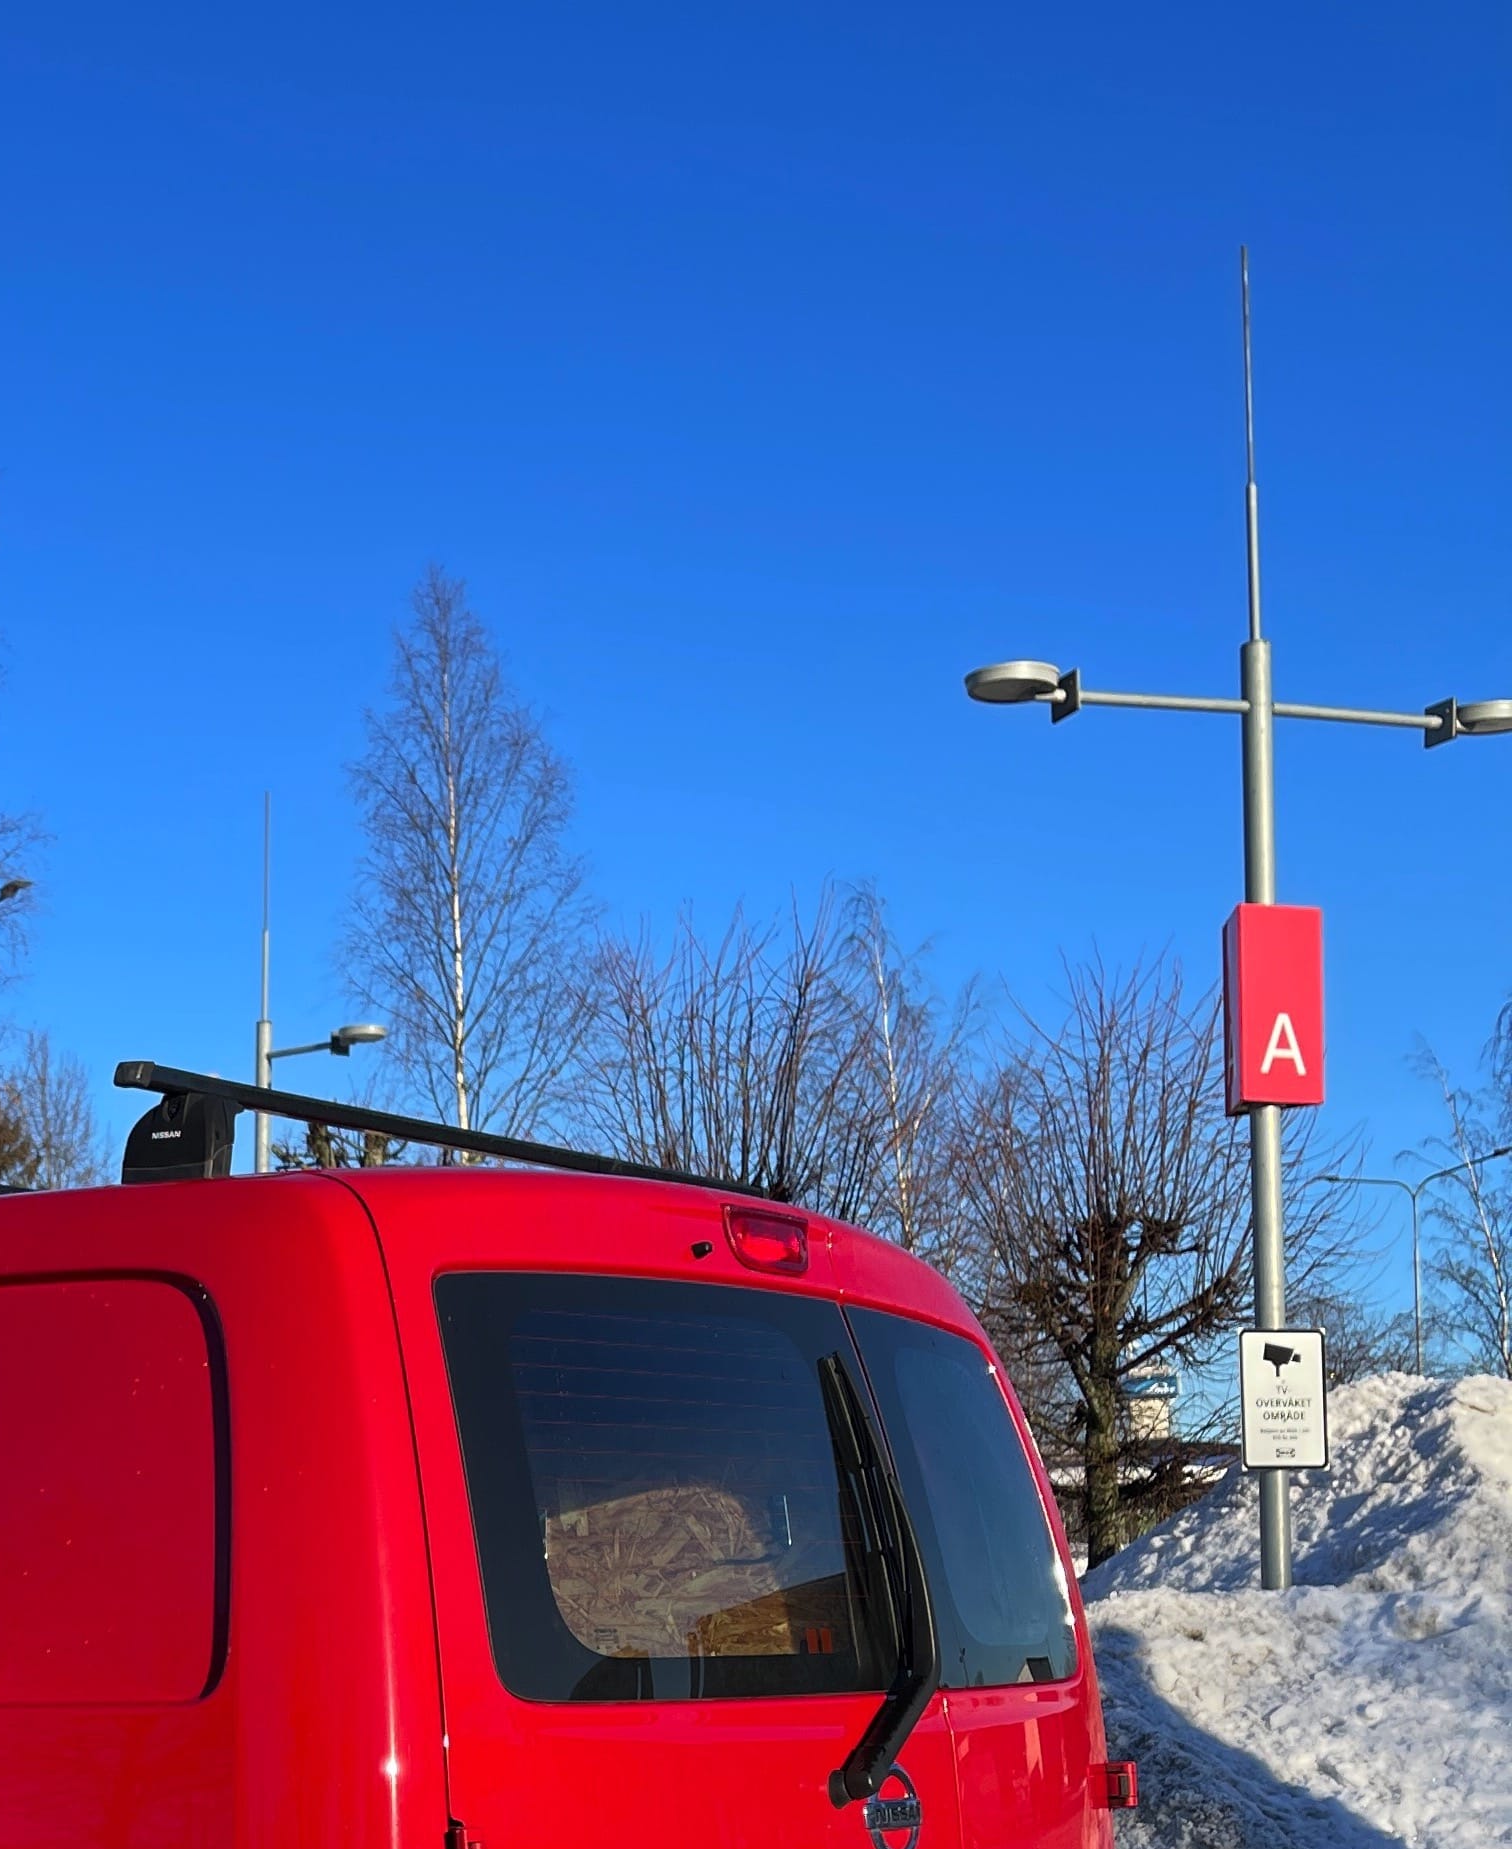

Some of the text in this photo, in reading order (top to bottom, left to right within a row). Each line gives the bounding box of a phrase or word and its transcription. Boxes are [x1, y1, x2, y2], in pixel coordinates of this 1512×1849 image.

[1260, 1013, 1307, 1076] A
[151, 1130, 182, 1140] NISSAN
[1255, 1397, 1312, 1408] OVERVÅKET
[1262, 1410, 1305, 1421] OMRÅDE
